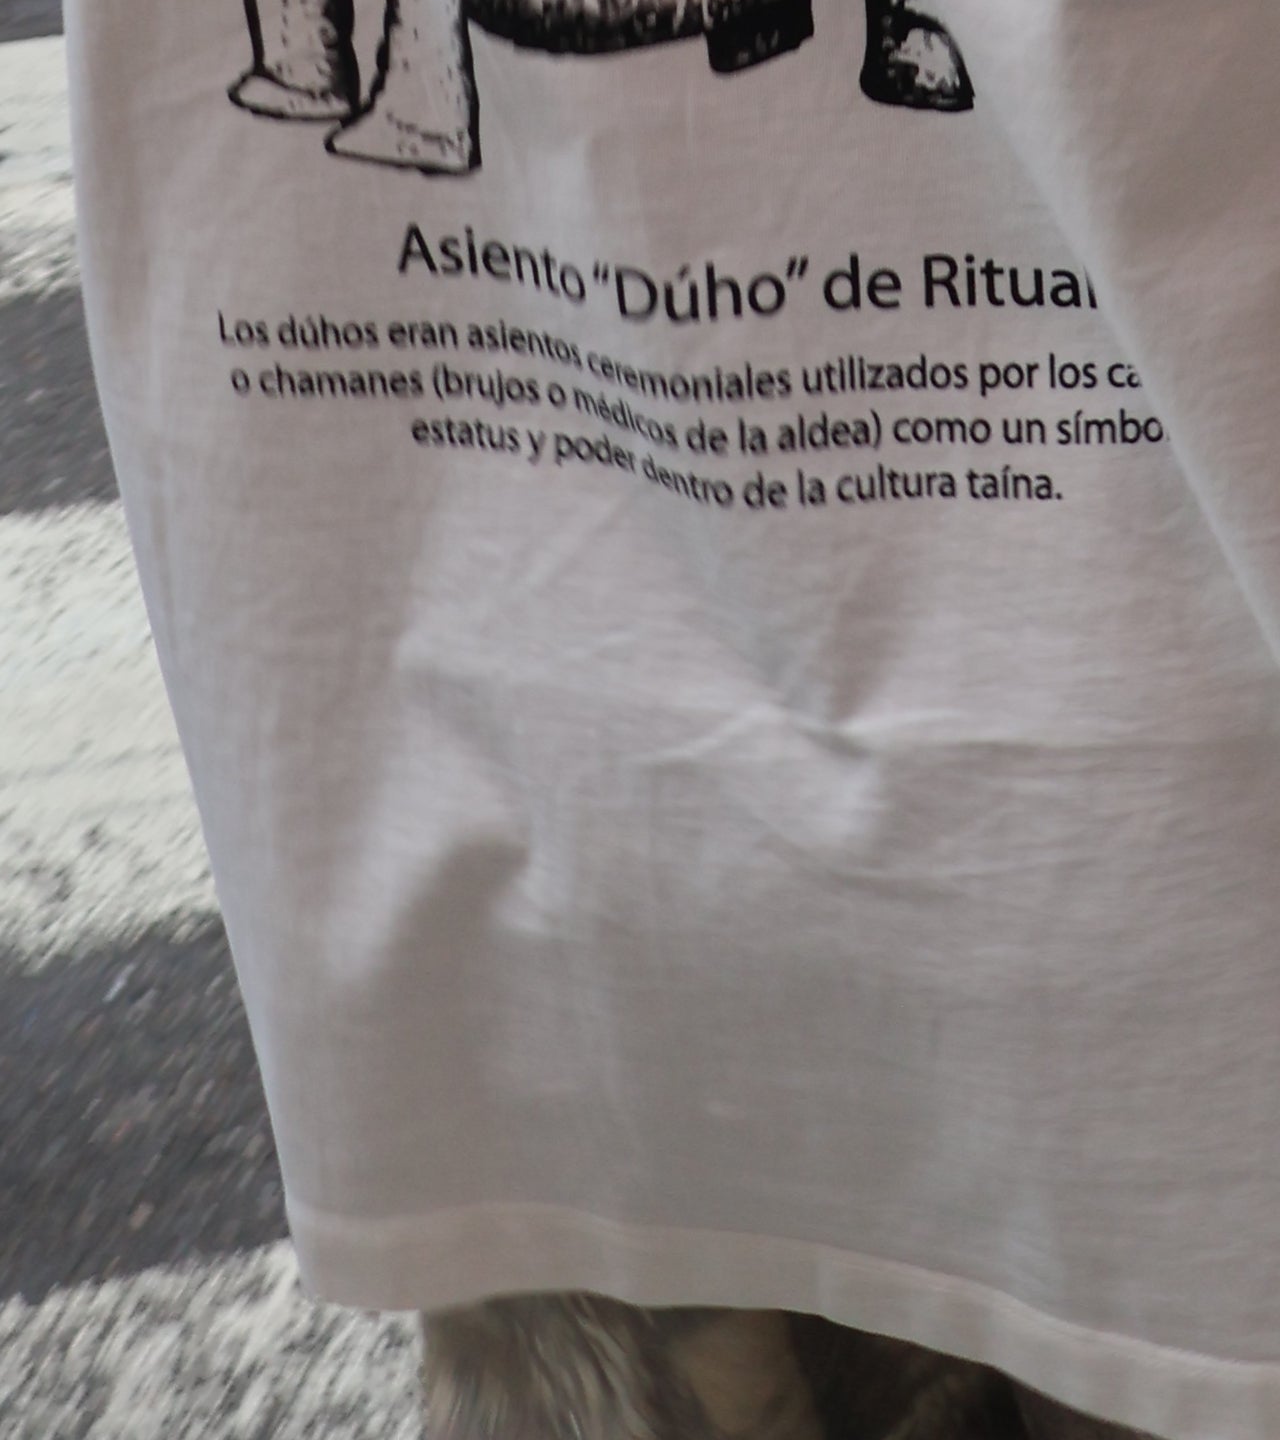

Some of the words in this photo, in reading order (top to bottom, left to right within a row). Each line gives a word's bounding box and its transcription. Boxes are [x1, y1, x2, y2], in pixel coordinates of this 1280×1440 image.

[397, 221, 587, 305] Asiento
[823, 251, 902, 310] de
[218, 310, 270, 347] Los
[277, 313, 380, 351] dúhos
[387, 321, 459, 350] eran
[467, 319, 584, 369] asientos
[586, 349, 793, 404] ceremoniales
[802, 353, 970, 396] utilizados
[978, 362, 1039, 398] por
[1048, 352, 1098, 390] los
[230, 367, 252, 398] o
[259, 362, 425, 400] chamanes
[432, 362, 541, 408] (brujos
[547, 381, 567, 409] o
[573, 385, 678, 450] médicos
[686, 417, 729, 455] de
[738, 416, 769, 455] la
[777, 409, 882, 452] aldea)
[892, 417, 991, 444] como
[1002, 418, 1046, 445] un
[1056, 408, 1166, 445] símbo
[410, 415, 521, 453] estatus
[527, 429, 546, 465] y
[553, 433, 637, 473] poder
[641, 454, 734, 507] dentro
[743, 470, 788, 509] de
[796, 468, 827, 506] la
[836, 463, 957, 503] cultura
[965, 465, 1064, 502] taína.
